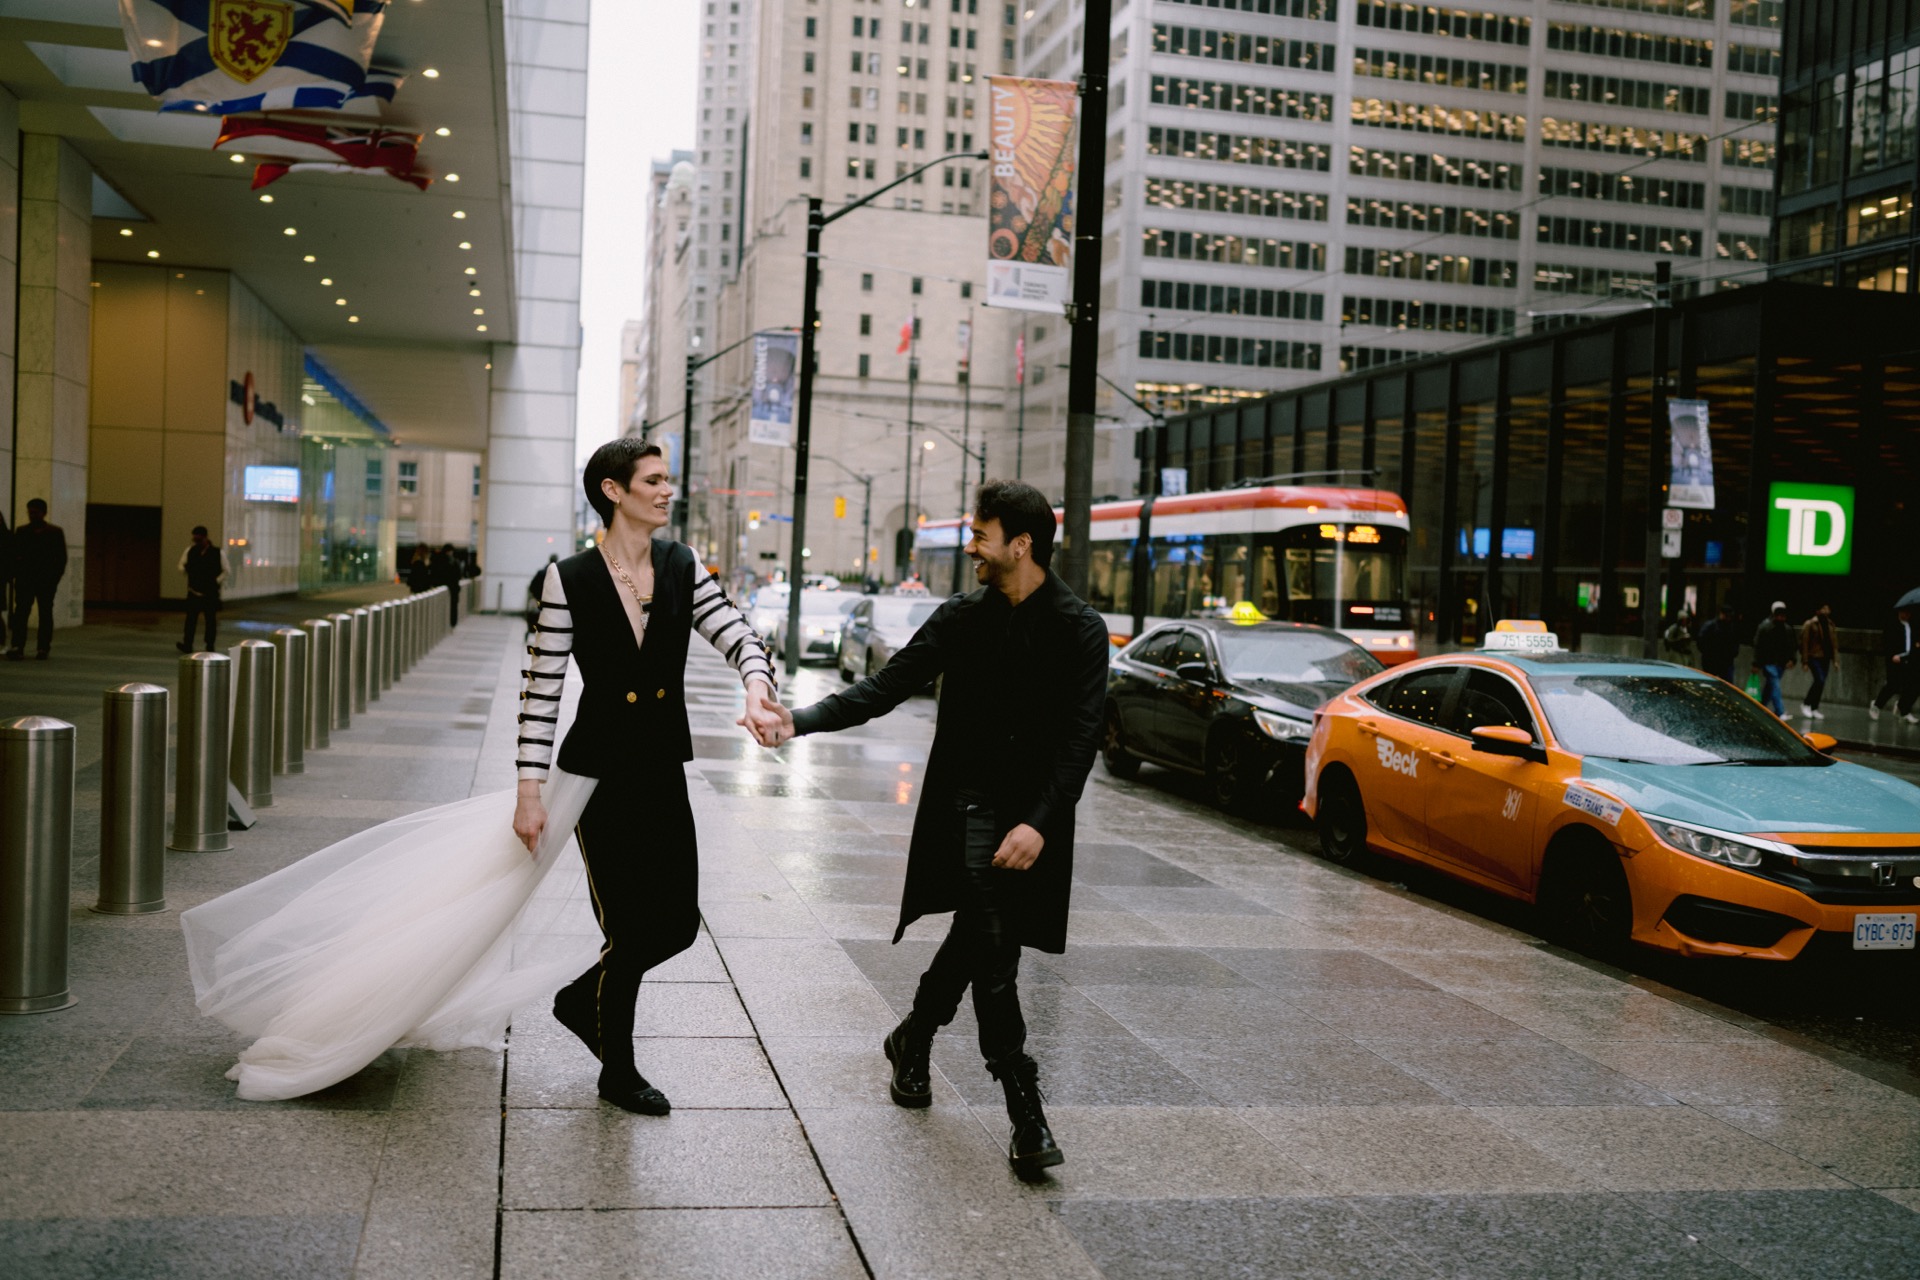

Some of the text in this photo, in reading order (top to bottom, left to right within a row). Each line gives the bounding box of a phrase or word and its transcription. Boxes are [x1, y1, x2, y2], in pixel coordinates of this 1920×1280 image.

[991, 85, 1015, 177] BEAUTY
[754, 336, 768, 391] CONNECT
[1774, 497, 1847, 557] TD
[1501, 634, 1554, 648] 751-5555
[1376, 736, 1420, 778] Beck
